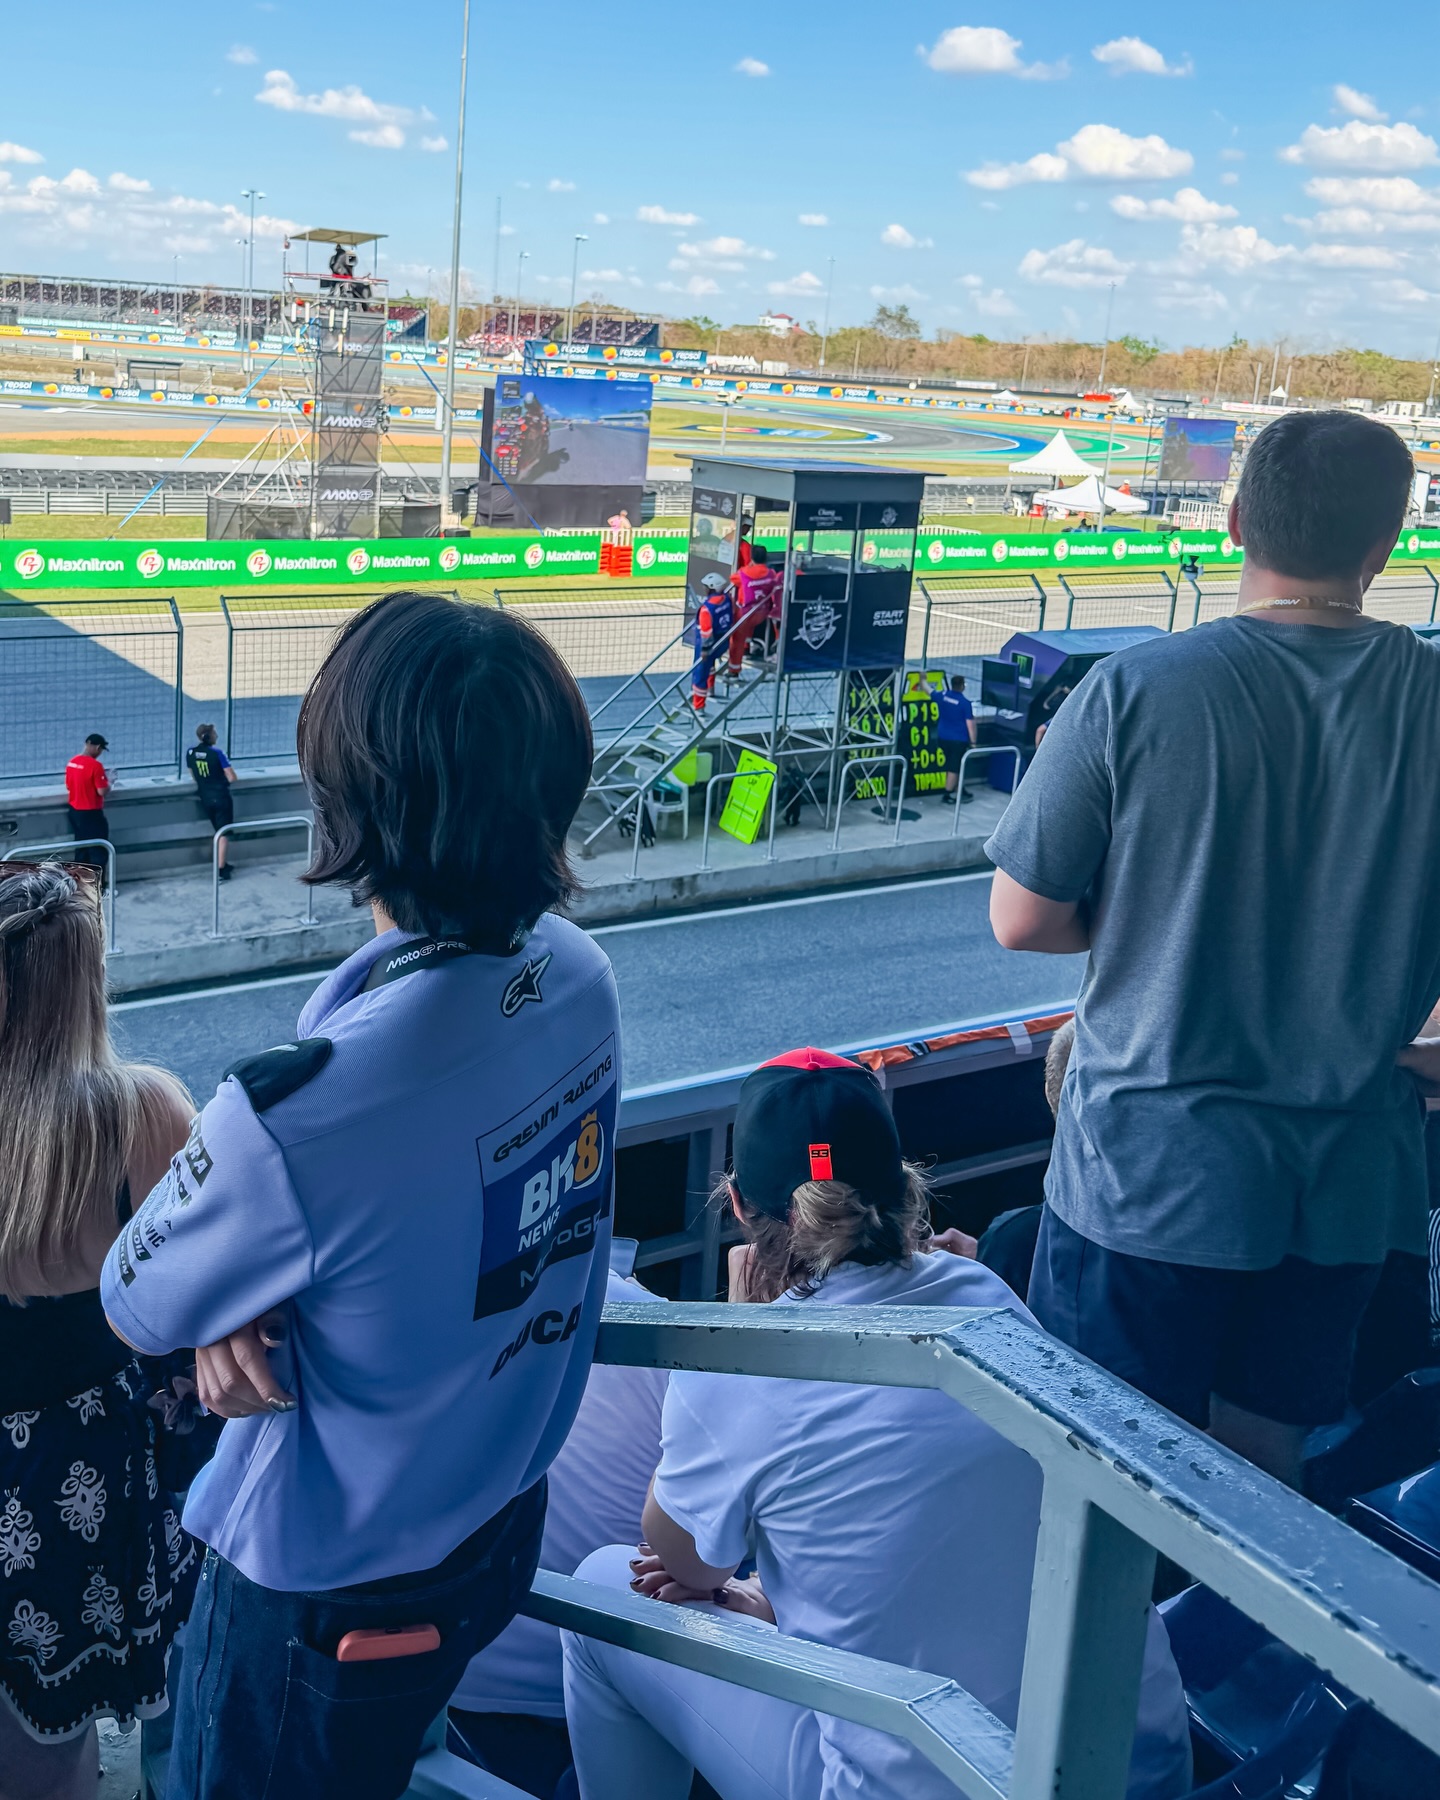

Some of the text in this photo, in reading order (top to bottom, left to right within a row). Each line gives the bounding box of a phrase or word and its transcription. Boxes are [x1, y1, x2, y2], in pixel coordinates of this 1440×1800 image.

[619, 347, 646, 358] repsol
[676, 351, 701, 361] repsol
[4, 381, 32, 390] repsol
[61, 384, 89, 393] repsol
[115, 388, 140, 397] repsol
[167, 392, 194, 401] repsol
[322, 415, 377, 428] MotoGP
[320, 488, 374, 501] MotoGP
[274, 556, 337, 570] Maxnitron
[373, 555, 430, 567] Maxnitron
[462, 552, 516, 565] Maxnitron
[546, 550, 597, 563] Maxnitron
[48, 558, 124, 572] Maxnitron
[167, 557, 236, 571] Maxnitron
[873, 610, 904, 620] START
[872, 619, 904, 627] PODIUM
[386, 944, 436, 973] MotoGP
[493, 1054, 612, 1163] GRESINI RACING
[518, 1120, 604, 1231] BK8
[517, 1205, 561, 1252] NEWS
